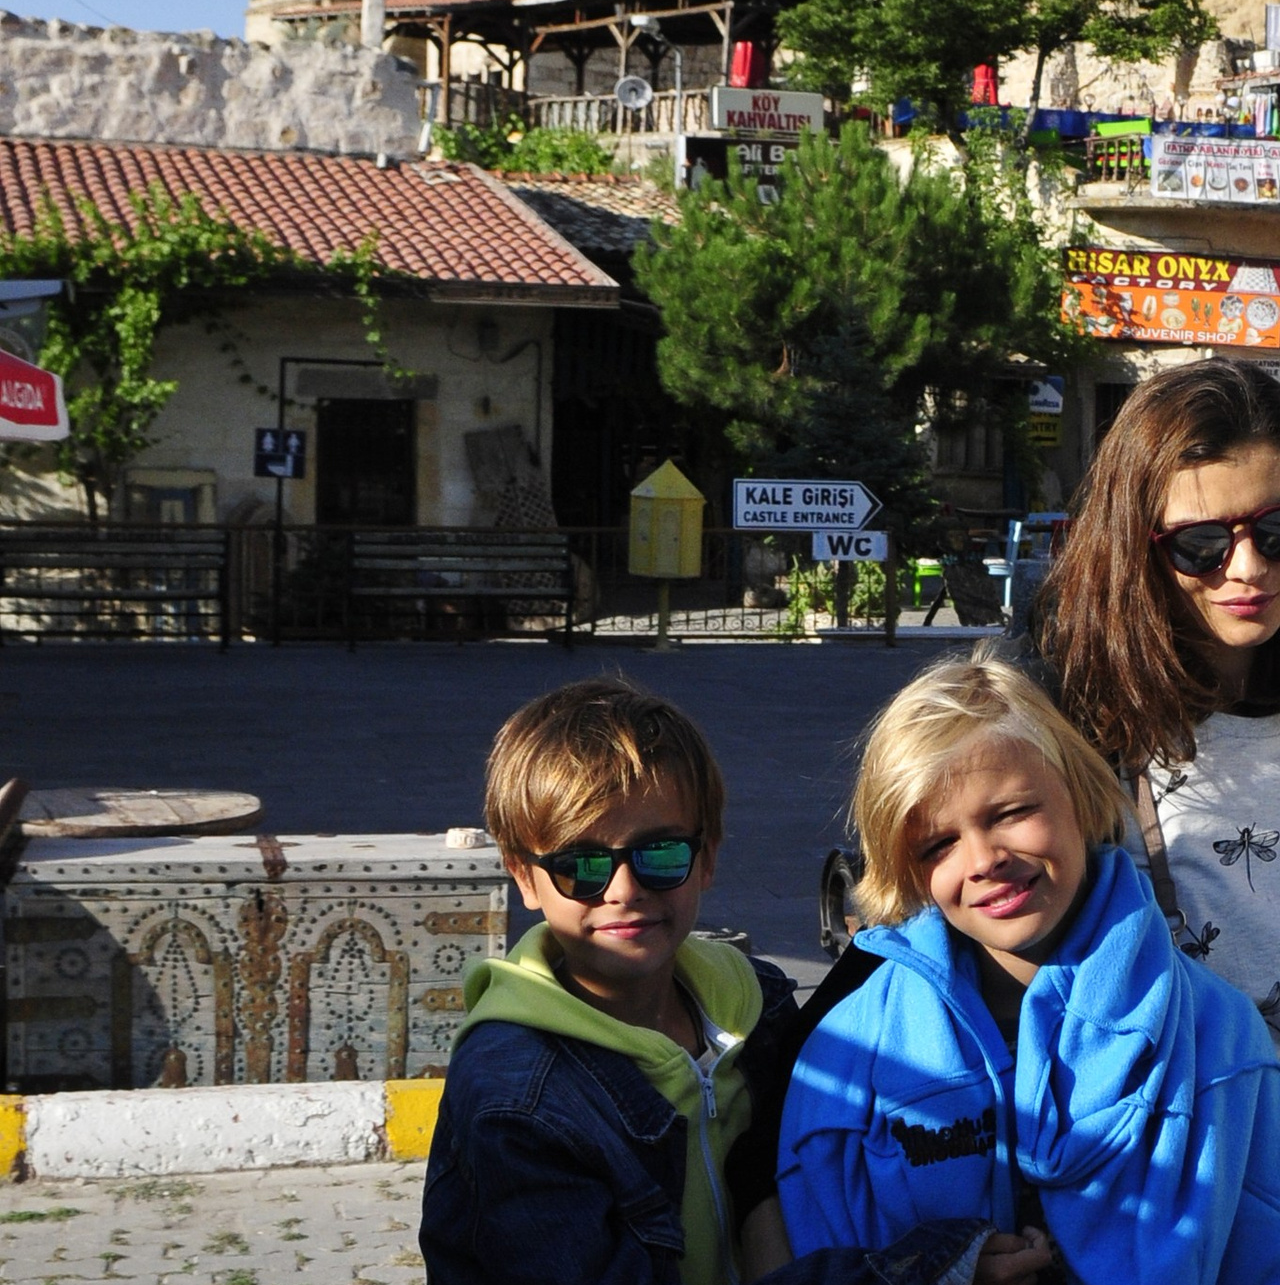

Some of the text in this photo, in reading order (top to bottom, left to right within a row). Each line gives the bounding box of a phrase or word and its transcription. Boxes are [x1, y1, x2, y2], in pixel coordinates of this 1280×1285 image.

[752, 92, 781, 111] KÖY
[1157, 255, 1231, 282] ONYX
[1071, 275, 1219, 291] FACTORY
[1121, 325, 1237, 343] SOUVENIR SHOP
[745, 487, 793, 505] KALE
[743, 511, 854, 524] CASTLE ENTRANCE
[827, 535, 872, 557] WC
